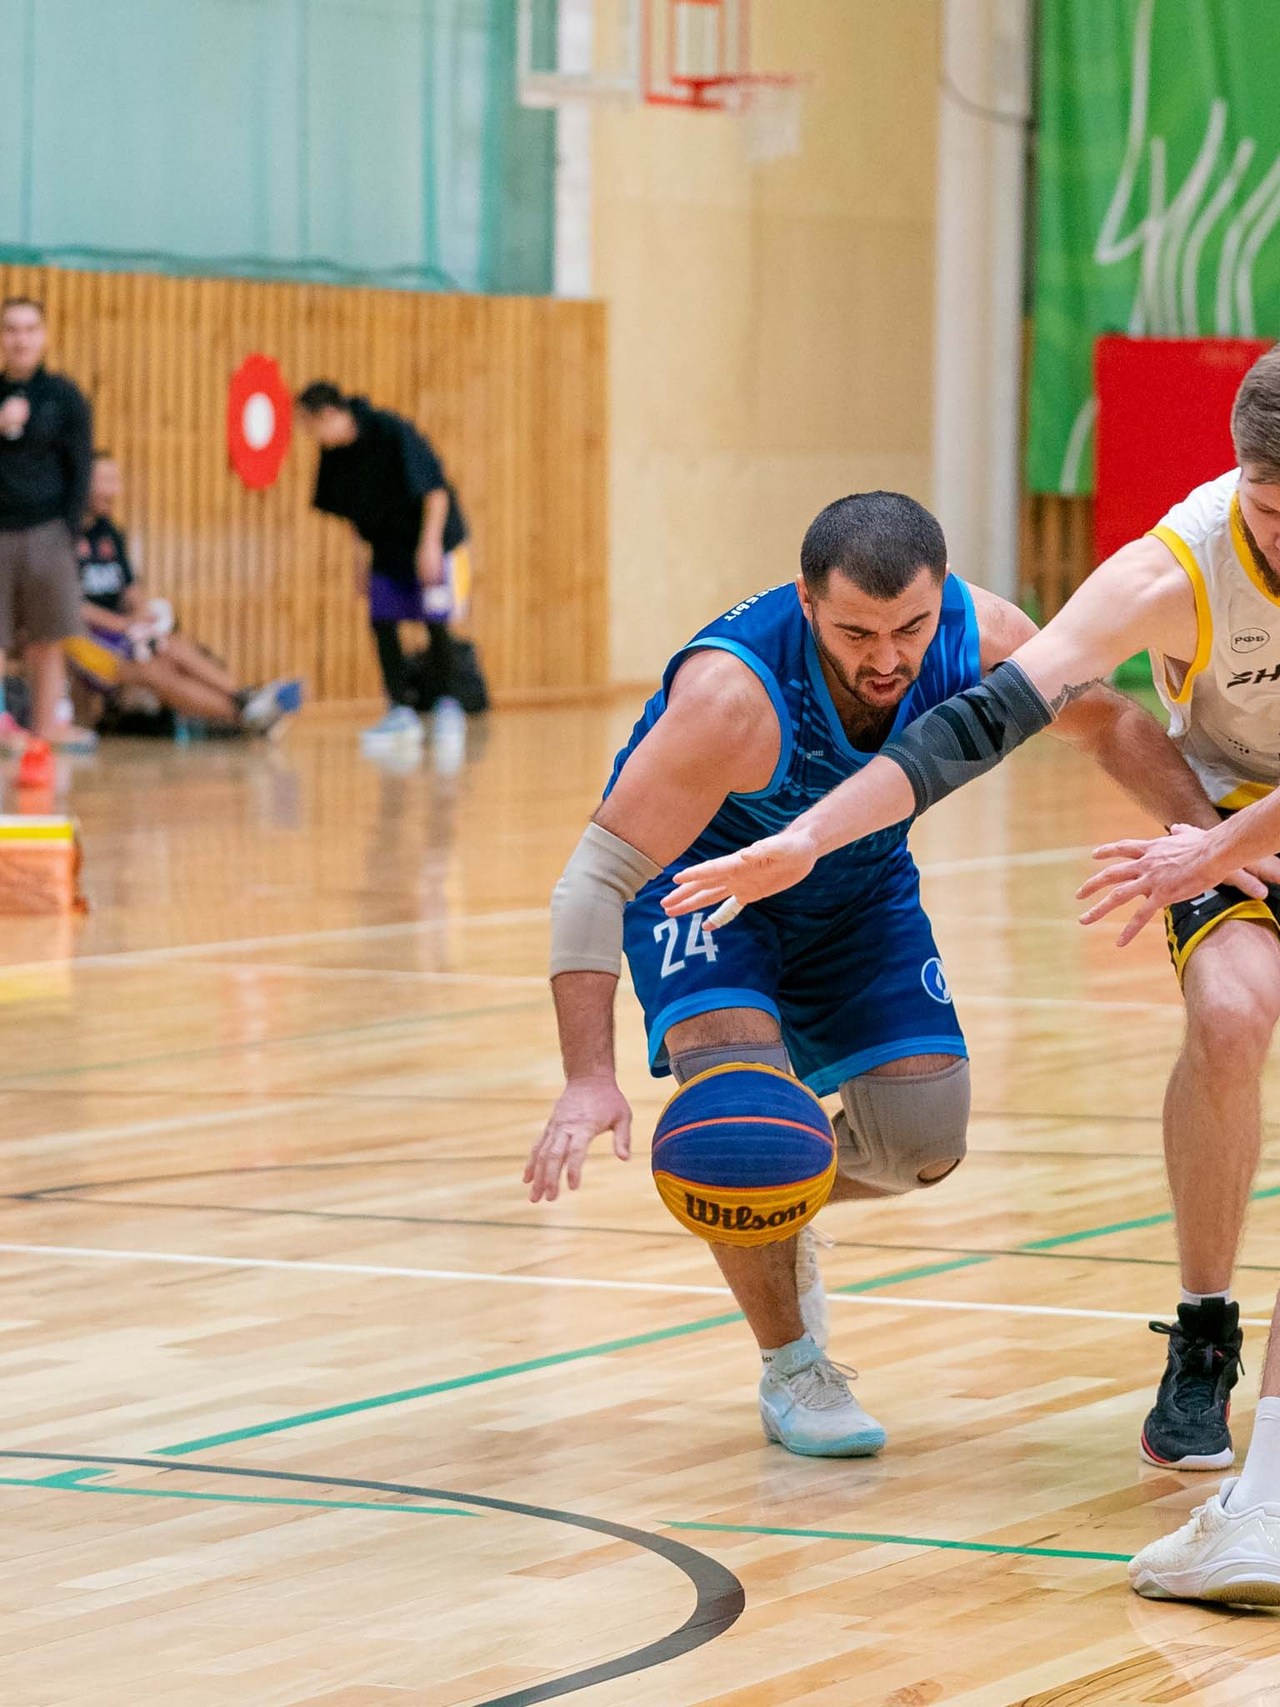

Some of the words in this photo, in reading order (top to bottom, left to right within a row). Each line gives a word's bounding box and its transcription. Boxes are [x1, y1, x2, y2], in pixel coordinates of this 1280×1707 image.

[1233, 635, 1266, 645] РФБ
[653, 912, 719, 980] 24
[684, 1191, 808, 1231] Wilson
